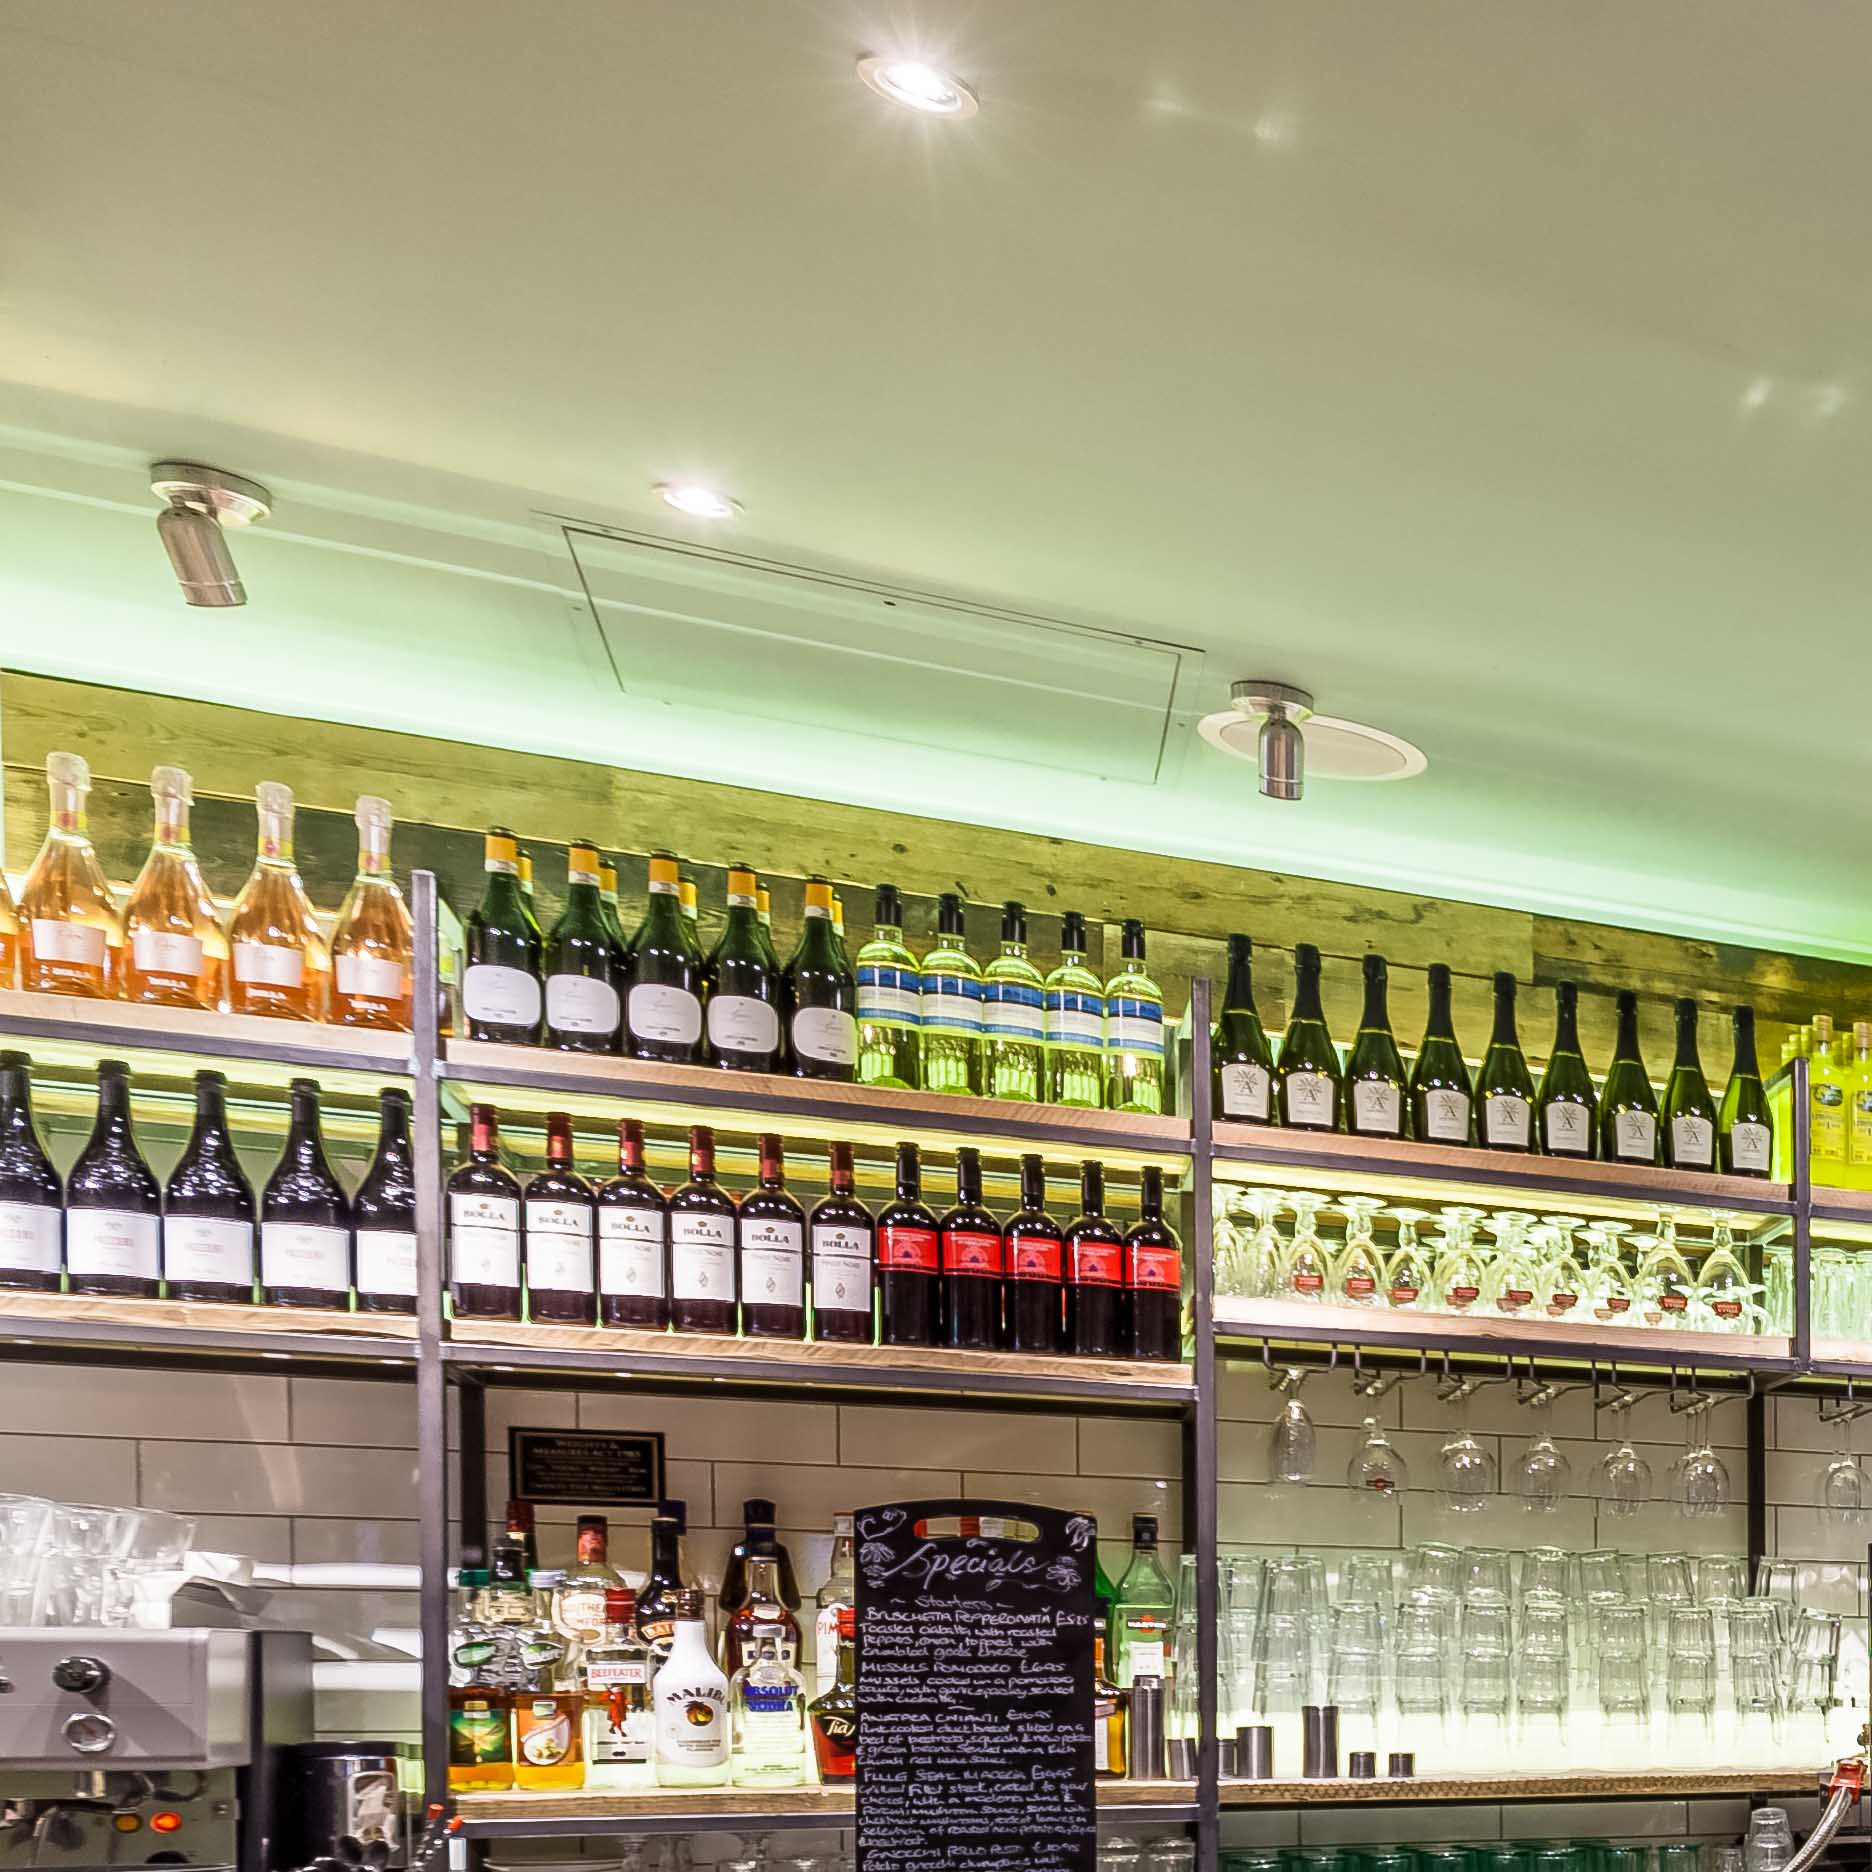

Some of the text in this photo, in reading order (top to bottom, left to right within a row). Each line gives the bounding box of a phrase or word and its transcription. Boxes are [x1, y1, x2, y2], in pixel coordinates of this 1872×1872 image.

[684, 1228, 723, 1239] BOLLA
[751, 1233, 790, 1244] BOLLA
[821, 1240, 860, 1251] BOLLA
[886, 1542, 1050, 1588] Specials
[591, 1668, 642, 1679] BEEFEATER
